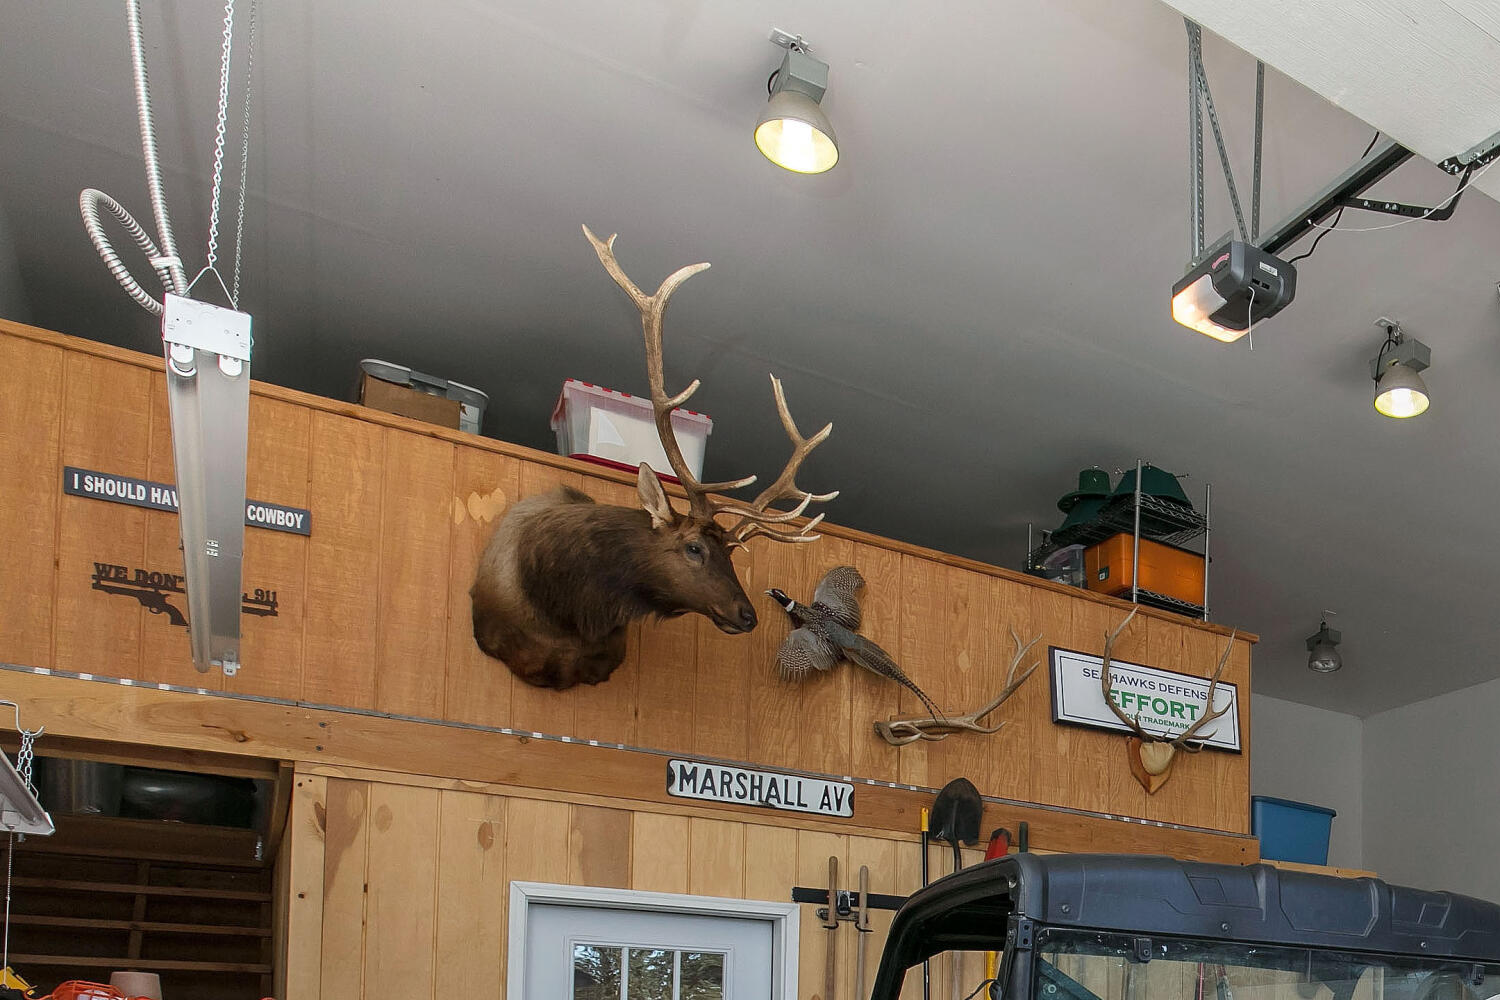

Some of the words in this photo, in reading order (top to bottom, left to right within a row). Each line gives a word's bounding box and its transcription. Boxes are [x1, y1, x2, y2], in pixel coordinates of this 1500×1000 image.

[73, 473, 79, 490] I
[83, 475, 147, 501] SHOULD
[151, 487, 178, 507] HAV
[246, 504, 304, 529] COWBOY
[94, 562, 128, 581] WE
[254, 588, 277, 602] 911
[1082, 667, 1156, 690] SEHAWKS
[1158, 683, 1214, 702] DEFENS
[1105, 689, 1200, 721] EFFORT
[1142, 716, 1190, 730] TRADEMARK
[678, 764, 808, 808] MARSHALL
[819, 785, 845, 812] AV
